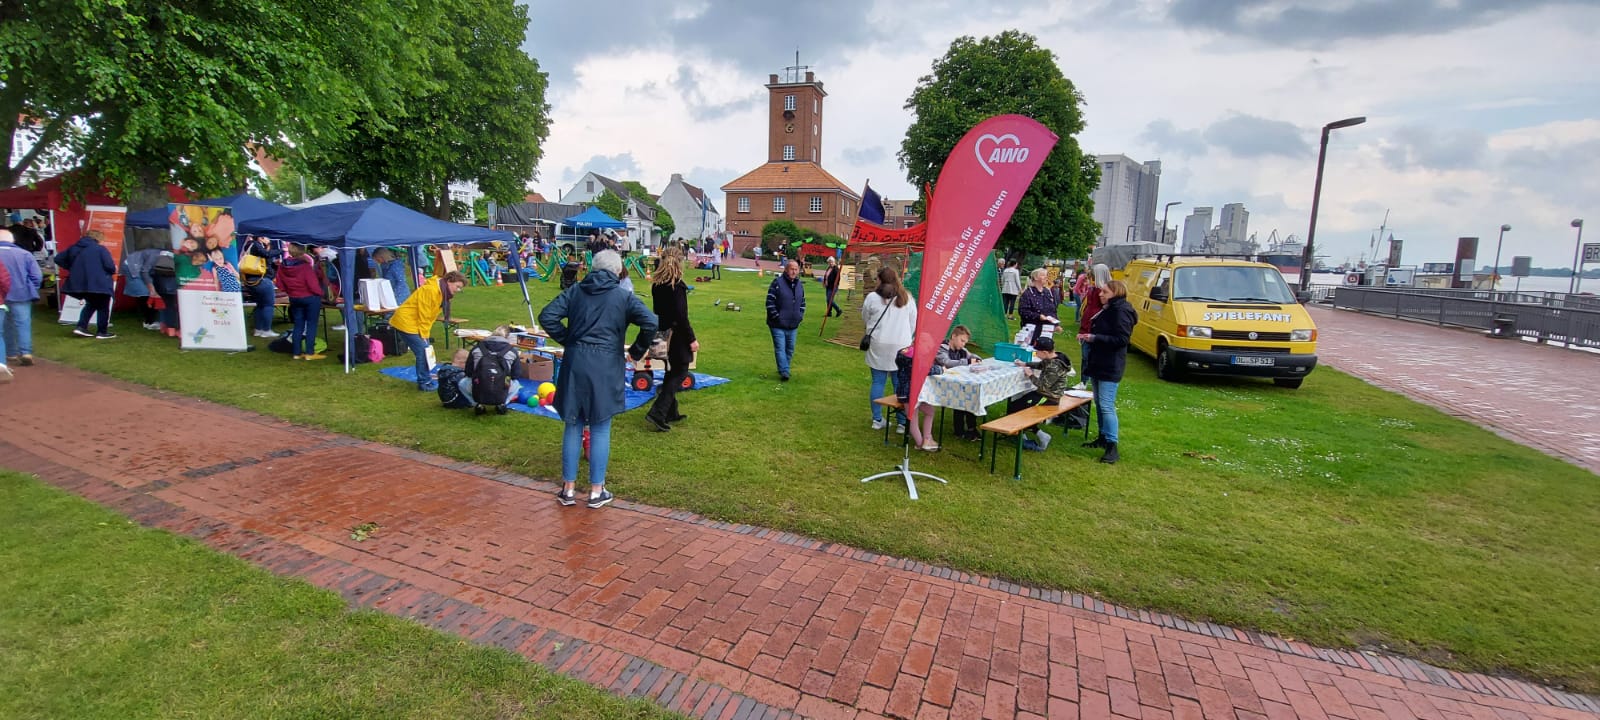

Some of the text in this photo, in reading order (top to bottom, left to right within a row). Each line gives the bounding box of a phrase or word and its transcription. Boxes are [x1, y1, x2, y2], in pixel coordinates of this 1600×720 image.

[988, 147, 1029, 163] AWO
[925, 226, 973, 310] Beratungsstelle für
[935, 190, 1008, 315] Kinder, Jugendliche & Eltern
[947, 257, 984, 320] www.awo-ol.de
[1203, 311, 1291, 323] SPIELEFANT
